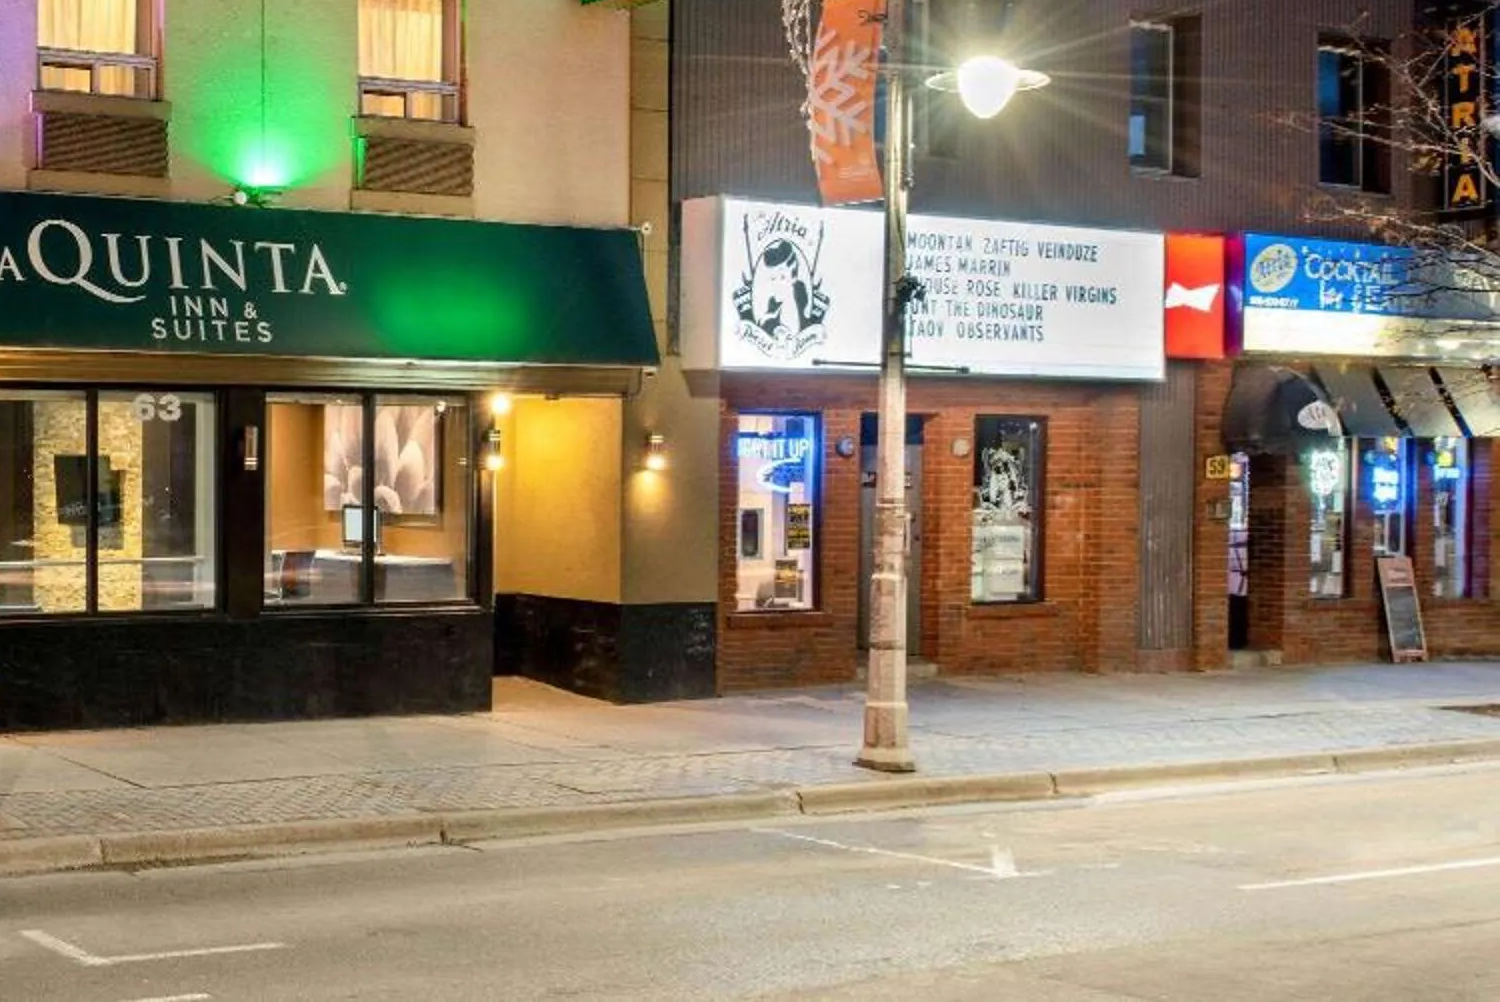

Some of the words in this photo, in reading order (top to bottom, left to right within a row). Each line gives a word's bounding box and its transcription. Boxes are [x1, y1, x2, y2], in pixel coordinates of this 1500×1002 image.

[27, 218, 347, 304] QUINTA
[906, 254, 951, 274] JAMES
[917, 277, 959, 296] OUSE
[966, 280, 1001, 298] ROSE
[1013, 282, 1058, 302] KILLER
[1065, 285, 1118, 305] VIRGINS
[169, 294, 230, 319] INN
[242, 300, 260, 321] &
[906, 299, 937, 317] UNT
[946, 300, 971, 319] THE
[977, 302, 1044, 321] DINOSAUR
[151, 318, 273, 343] SUITES
[956, 321, 1045, 343] OBSERVANTS
[132, 394, 182, 422] 63
